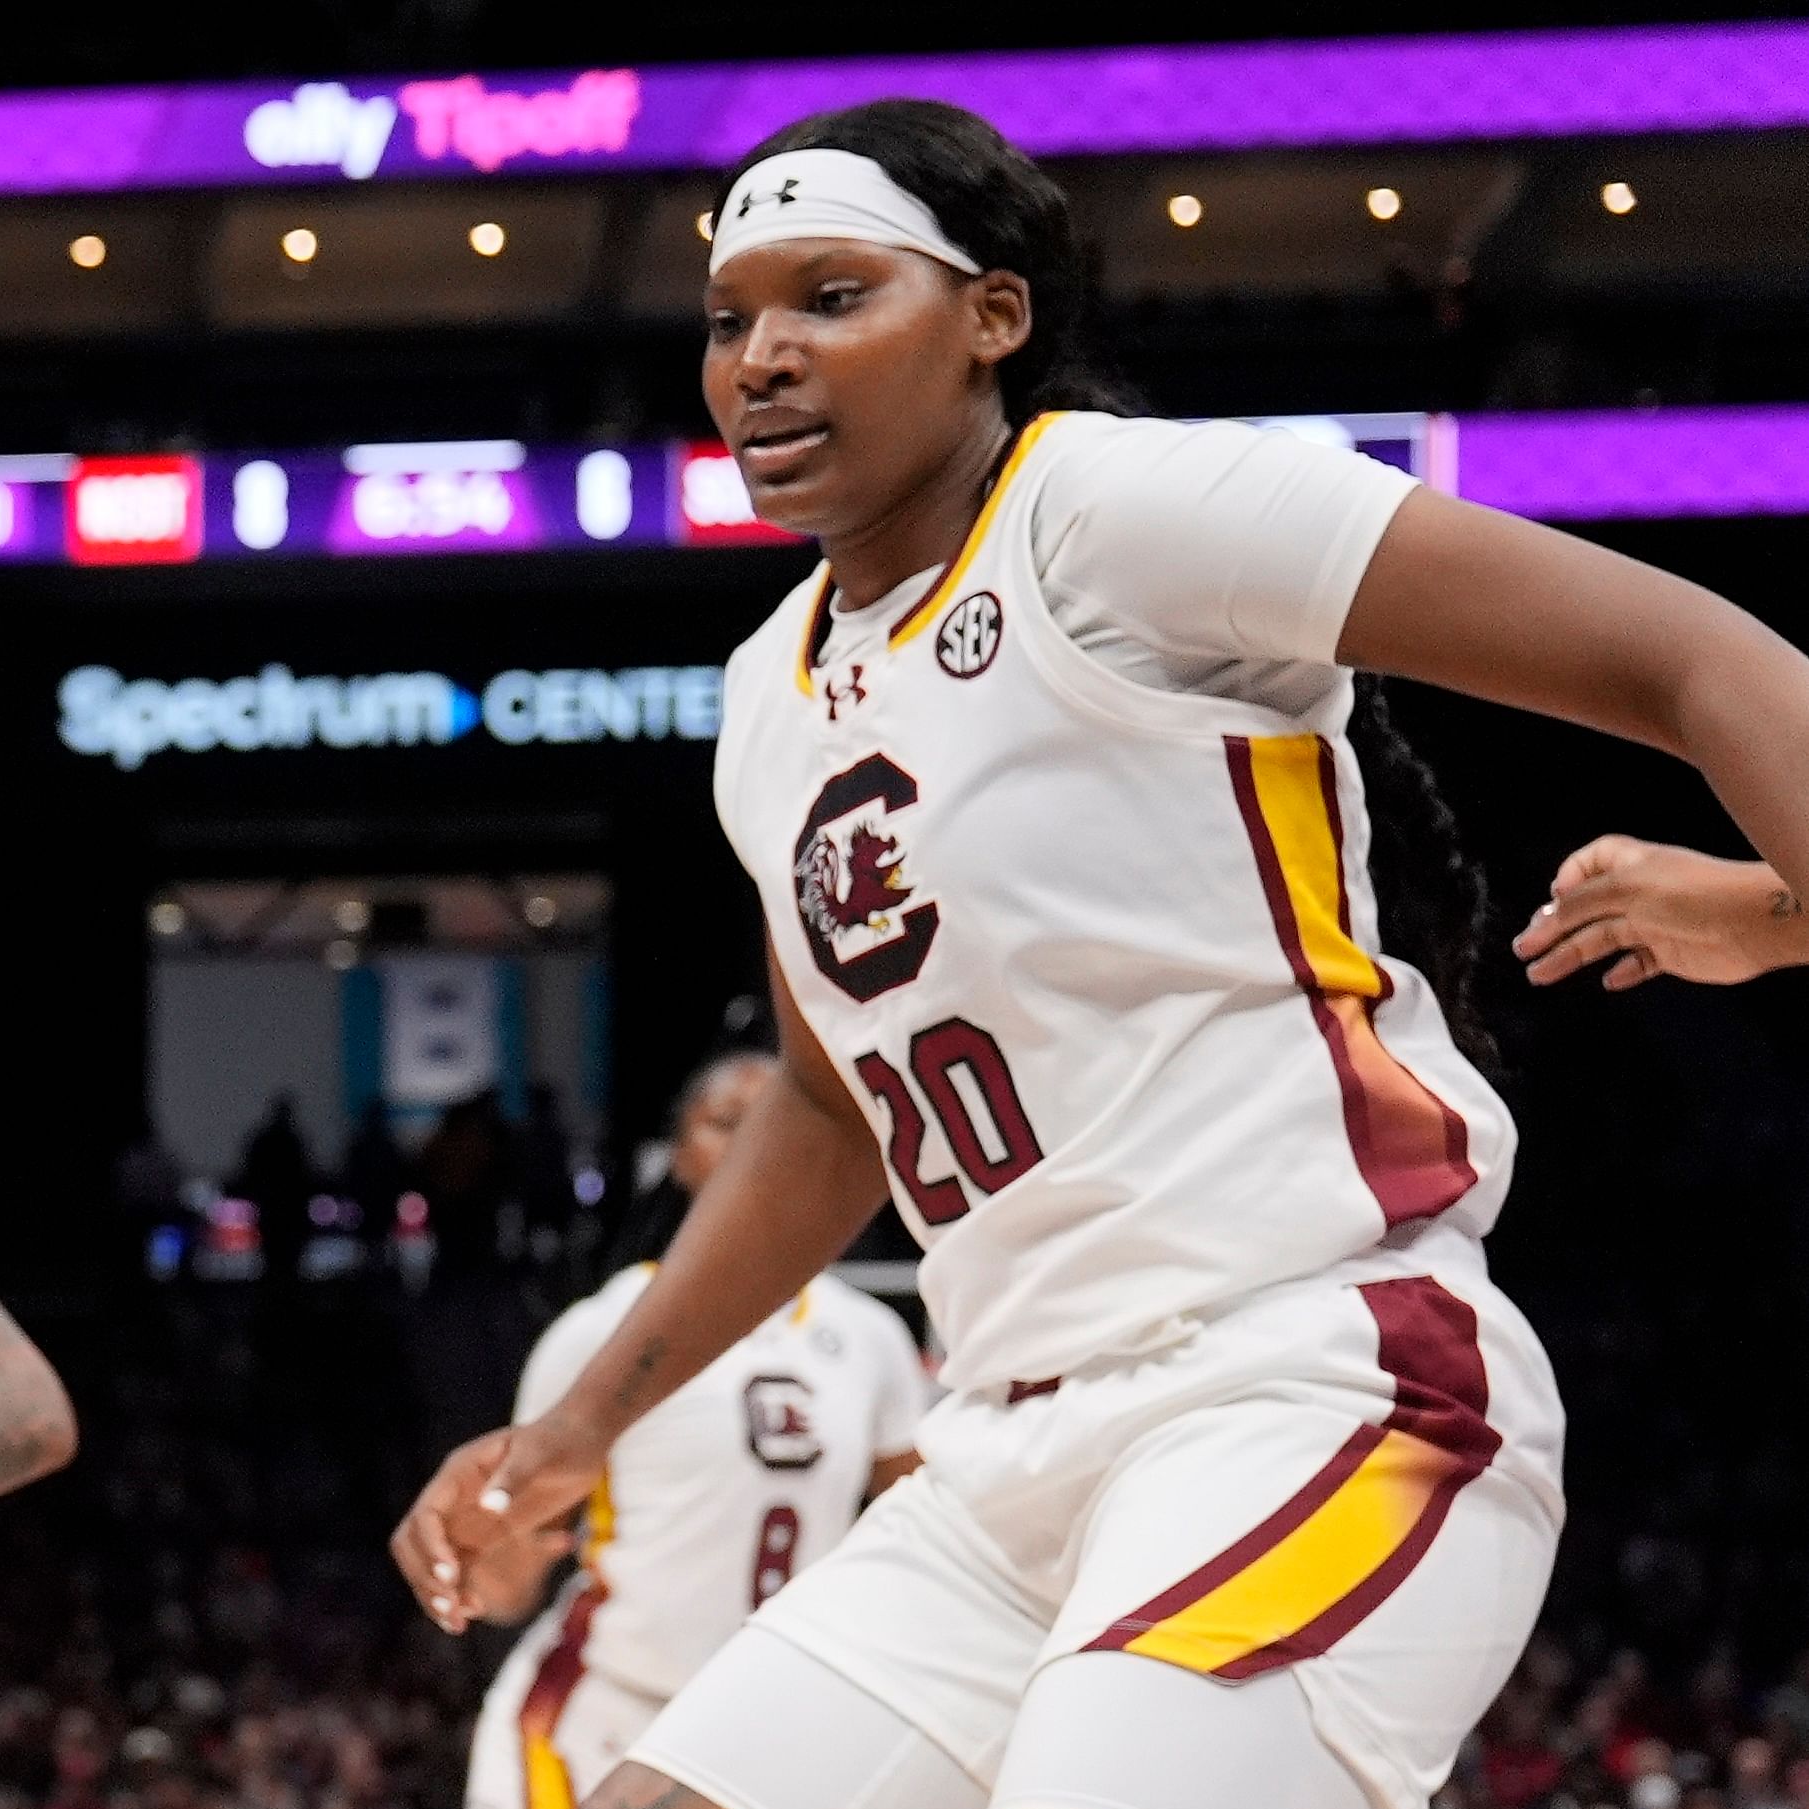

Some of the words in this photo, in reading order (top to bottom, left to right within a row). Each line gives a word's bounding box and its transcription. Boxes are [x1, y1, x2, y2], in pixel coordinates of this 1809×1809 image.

[939, 594, 1000, 674] SEC
[58, 664, 454, 771] Spectrum
[484, 667, 725, 745] CENTE
[854, 1015, 1046, 1226] 20
